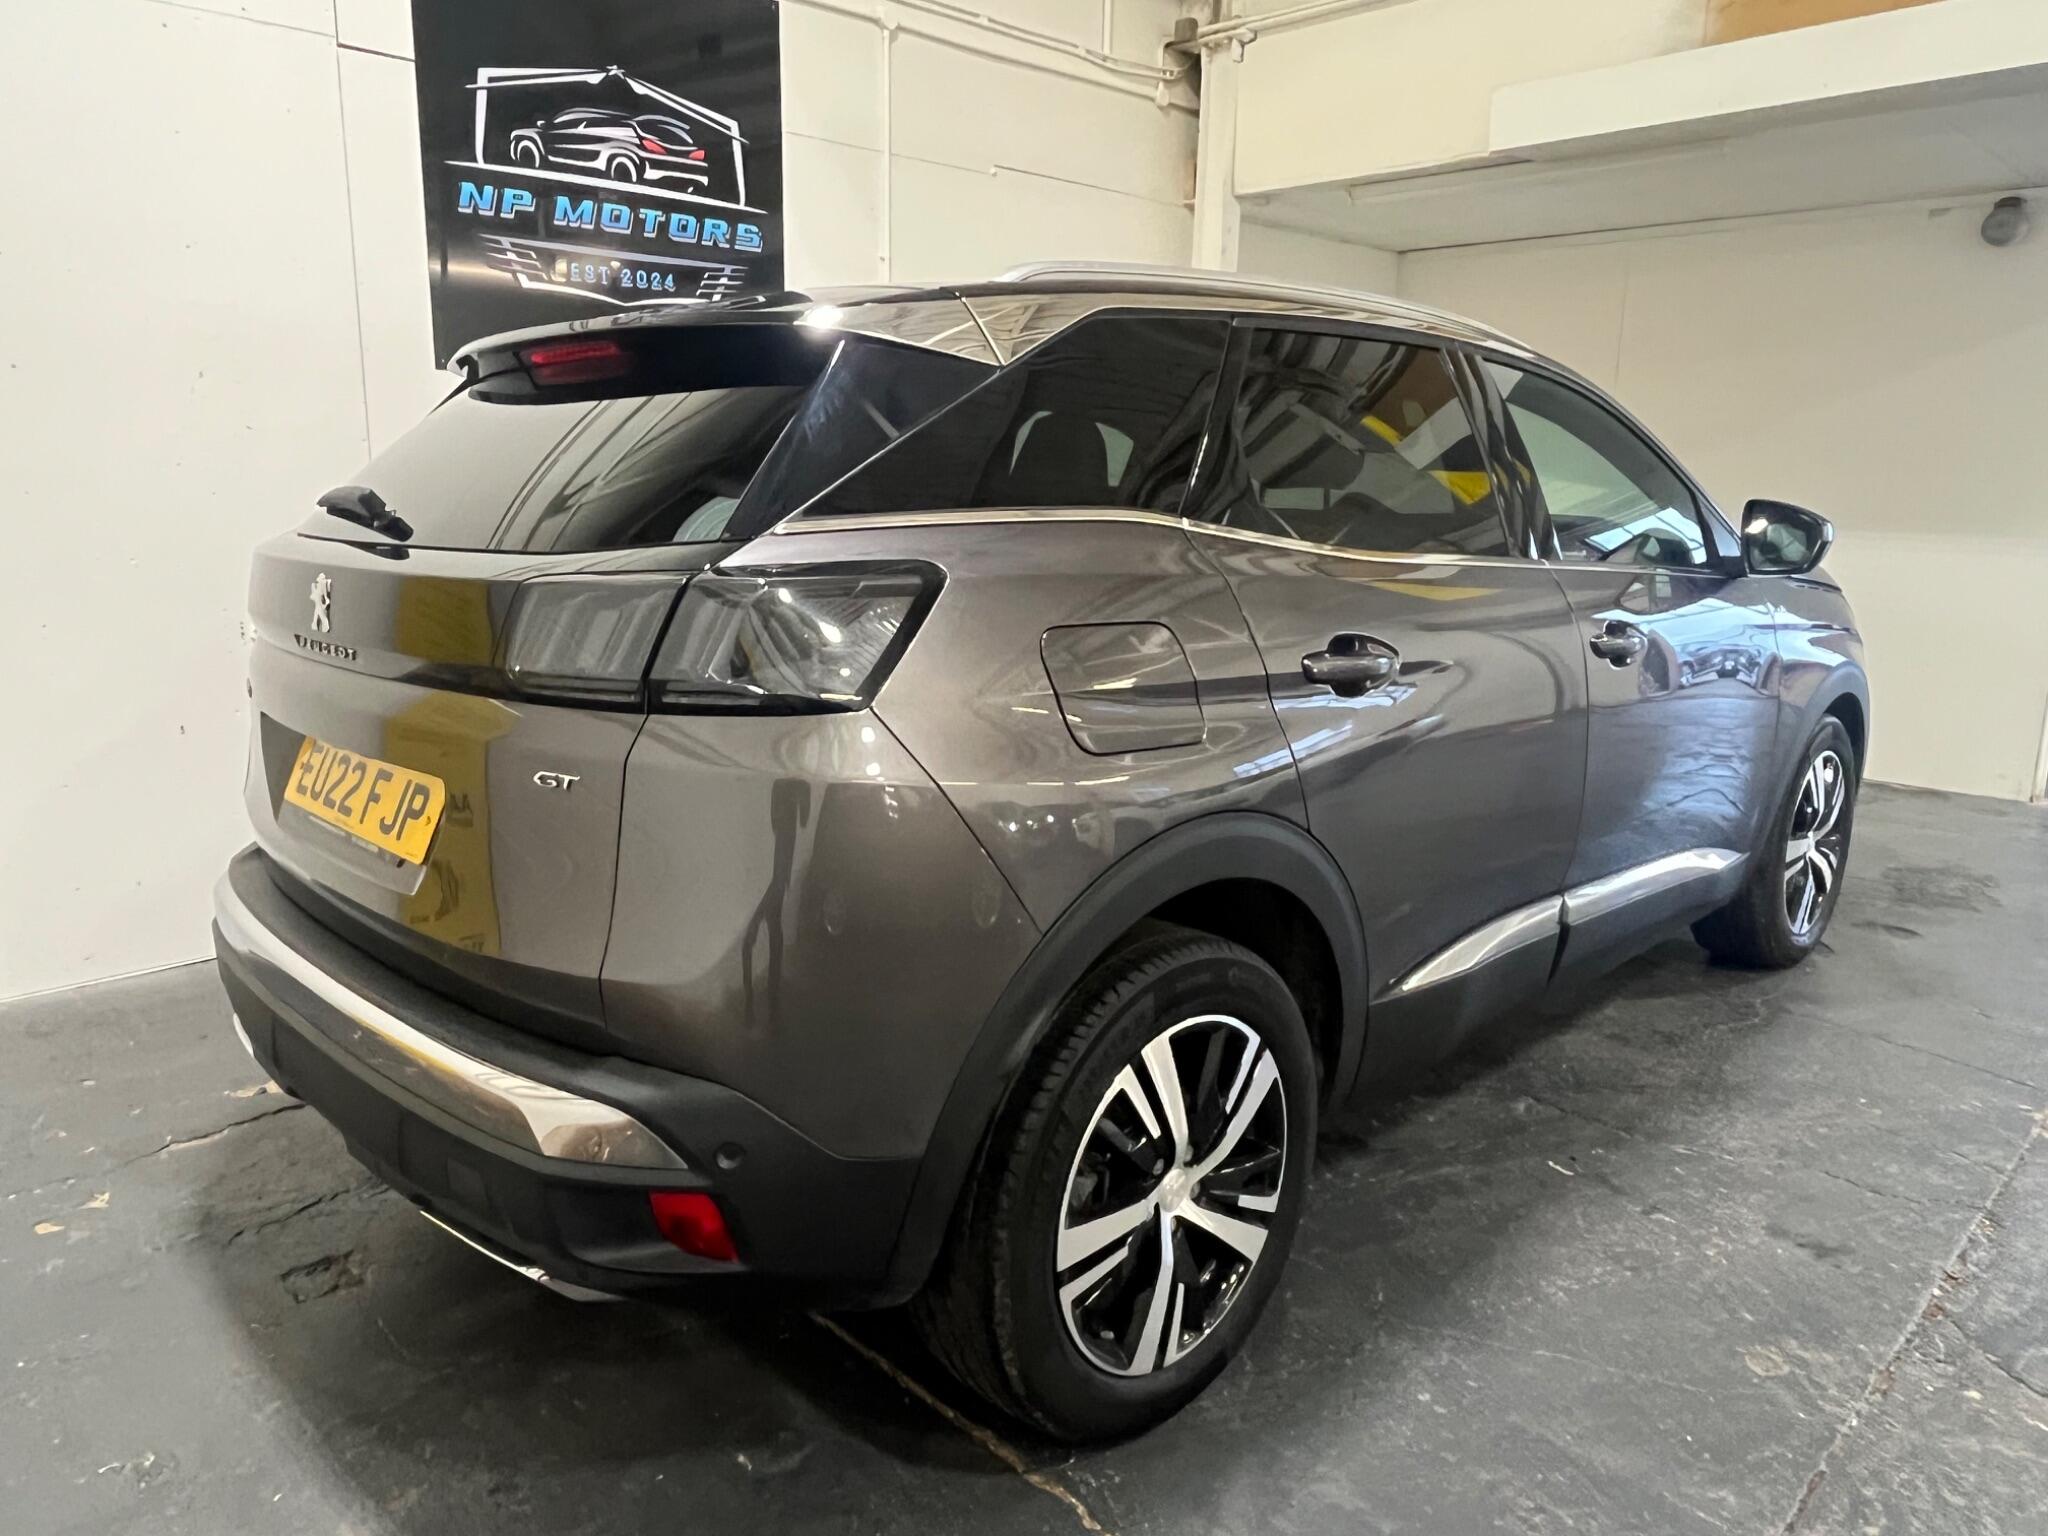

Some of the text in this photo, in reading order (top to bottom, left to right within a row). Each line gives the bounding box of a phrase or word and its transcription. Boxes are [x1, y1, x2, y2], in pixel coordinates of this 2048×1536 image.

[457, 181, 763, 252] NP MOTORS
[570, 262, 676, 292] EST 2024
[533, 771, 580, 790] GT
